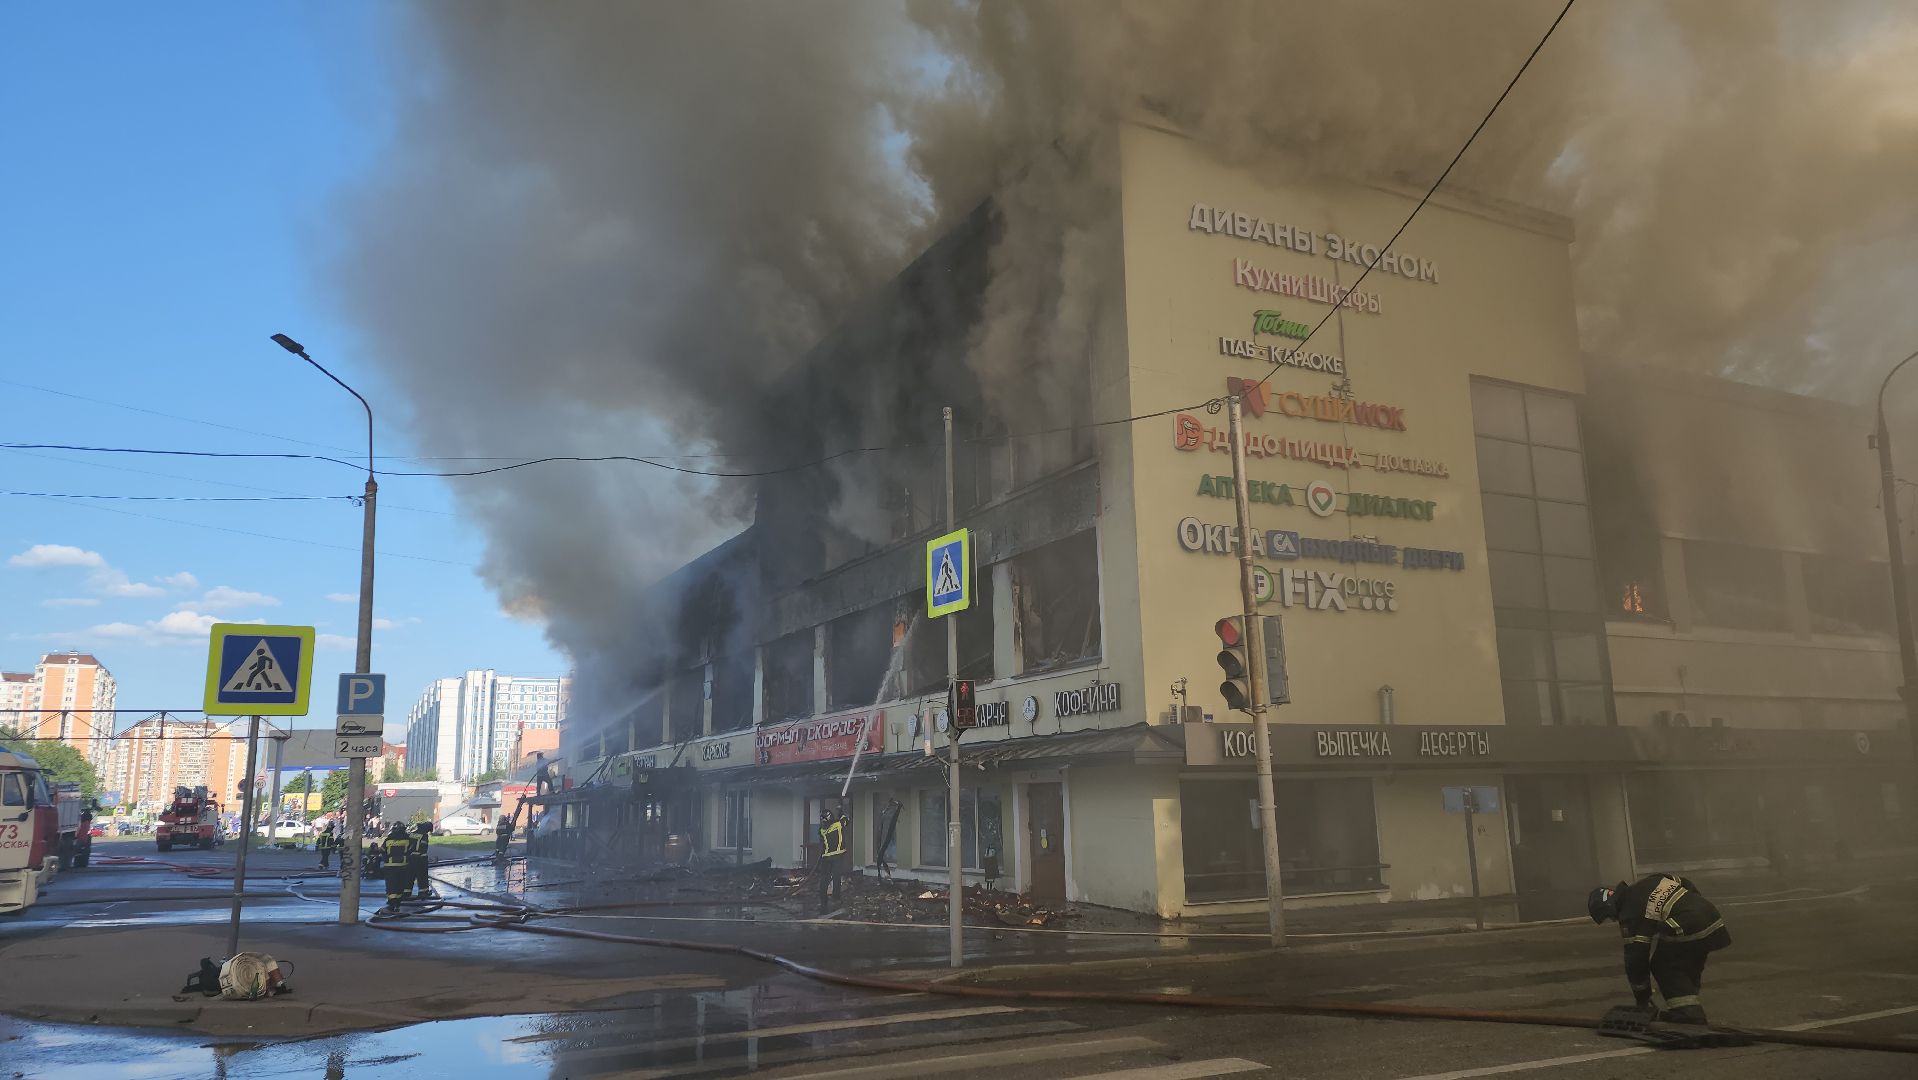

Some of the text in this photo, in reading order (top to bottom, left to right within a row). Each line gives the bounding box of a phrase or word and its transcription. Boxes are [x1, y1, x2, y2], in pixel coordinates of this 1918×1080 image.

[1190, 203, 1440, 284] ДИВАНЫ ЭКОНОМ
[1219, 337, 1344, 375] ПАБ КАРАОКЕ
[1375, 454, 1450, 478] ДОСТАВКА
[1197, 473, 1437, 521] АПЕКА ДИАЛОГ
[1299, 537, 1398, 565] ВХОДНЫЕ
[1402, 547, 1465, 571] ДВЕРИ
[1345, 577, 1395, 599] price
[348, 678, 373, 711] P
[1054, 684, 1119, 717] КОФЕЙНЯ
[339, 741, 379, 754] 2 часа
[1316, 731, 1392, 757] ВЫПЕЧКА
[1420, 731, 1491, 757] ДЕСЕРТЫ
